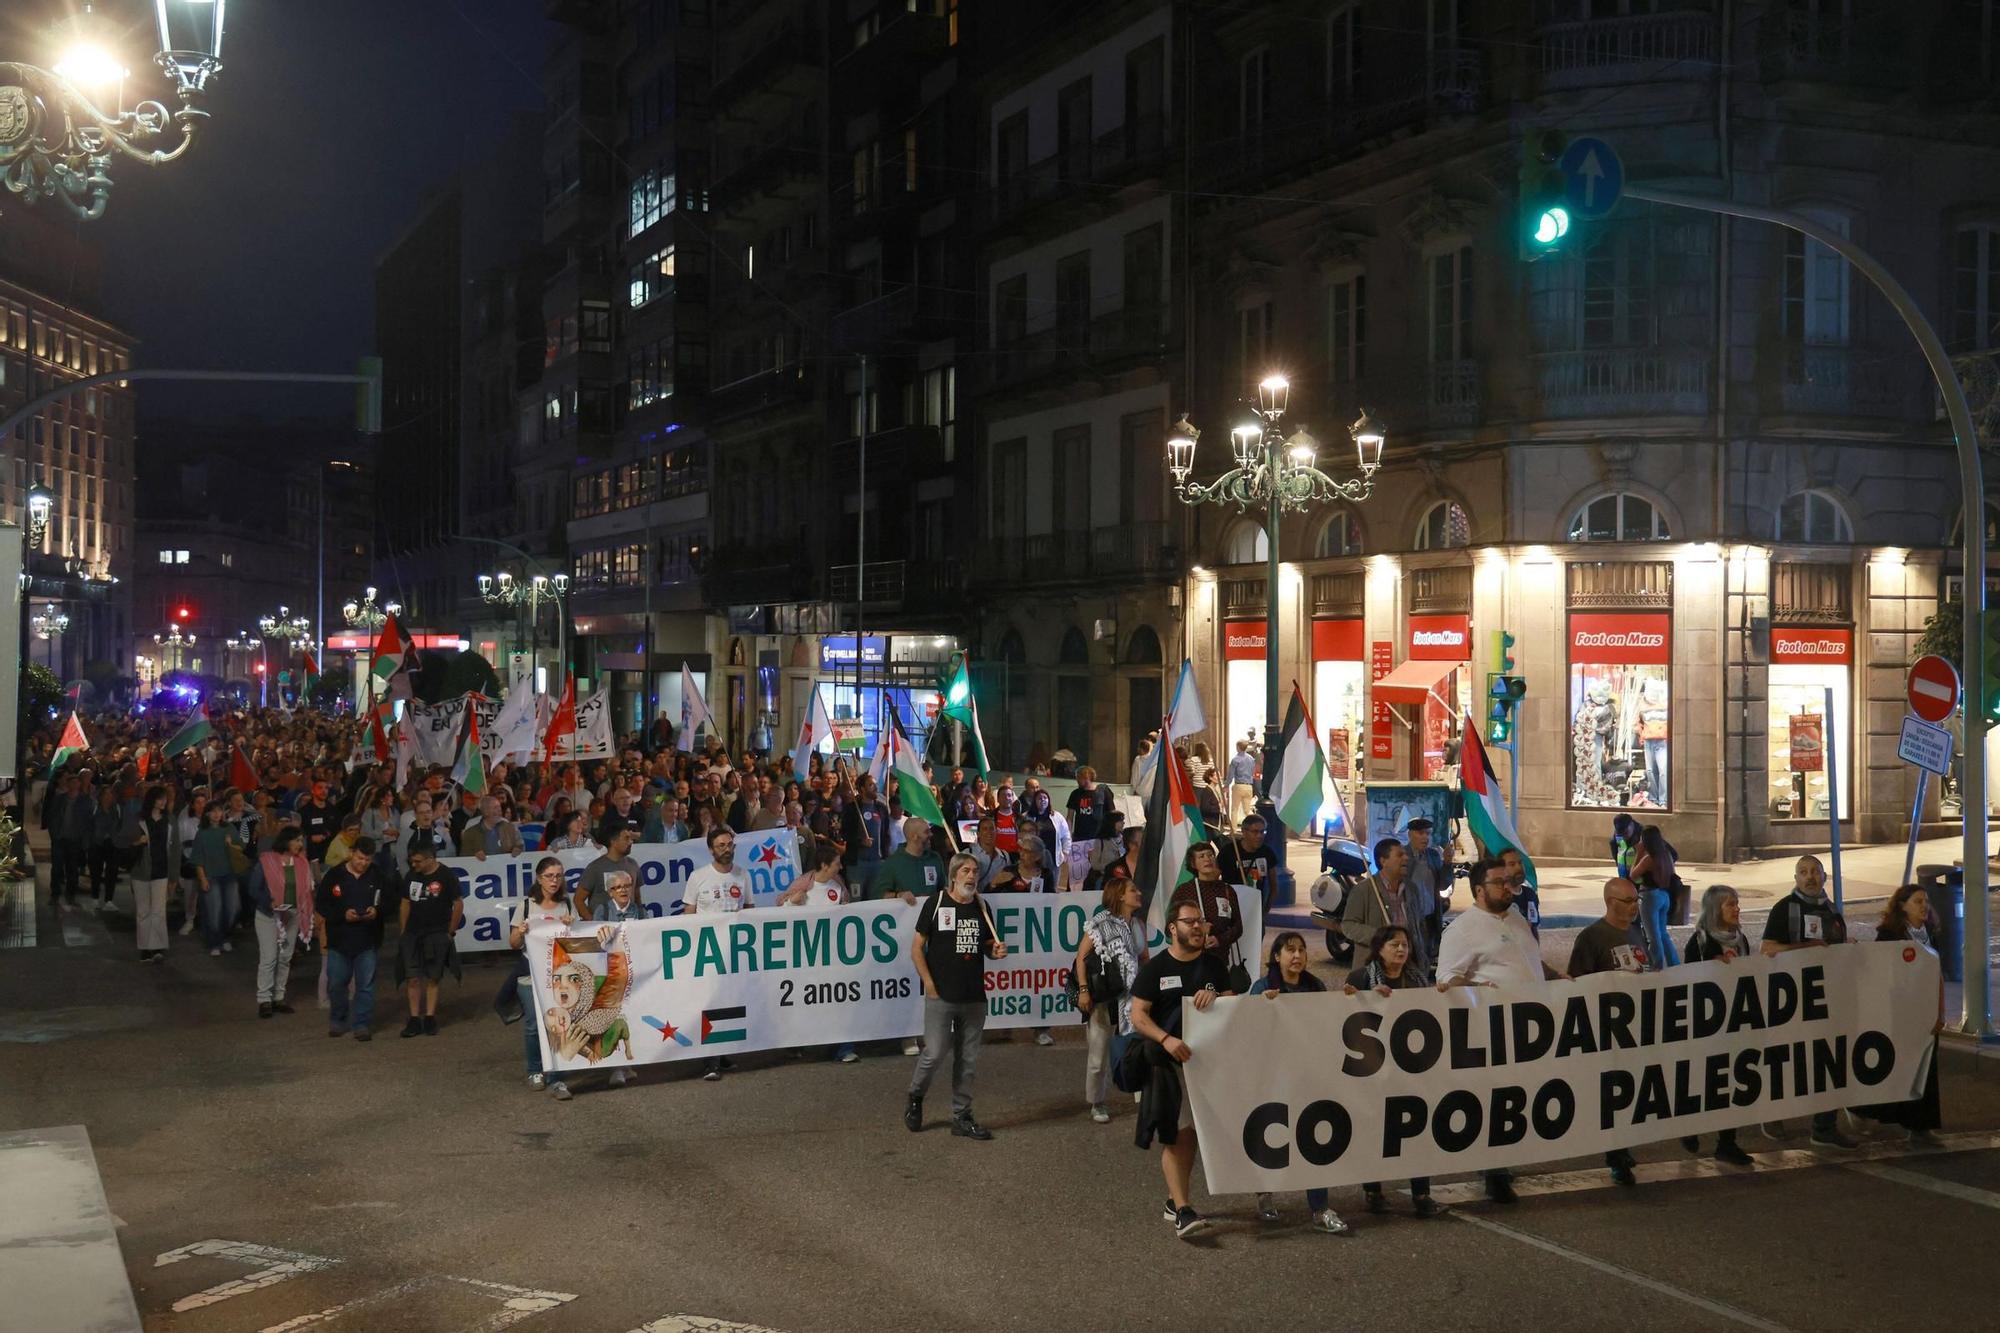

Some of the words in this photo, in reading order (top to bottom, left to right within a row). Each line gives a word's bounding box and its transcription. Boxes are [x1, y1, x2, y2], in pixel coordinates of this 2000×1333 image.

[1228, 635, 1243, 647] Foot
[1251, 635, 1266, 647] Mars
[1413, 631, 1431, 645] Foot
[1431, 633, 1442, 645] on
[1442, 631, 1464, 645] Mars
[1575, 632, 1607, 647] Foot
[1607, 636, 1625, 646] on
[1627, 632, 1664, 646] Mars
[1776, 639, 1802, 653] Foot
[1802, 642, 1816, 653] on
[1816, 639, 1845, 653] Mars
[449, 862, 586, 900] Galia
[640, 857, 694, 886] on
[956, 919, 980, 929] ANTI
[956, 928, 980, 937] IMPE
[661, 913, 899, 980] PAREMOS
[956, 936, 980, 946] RIAL
[955, 944, 979, 954] ISTA
[779, 980, 794, 1007] 2
[803, 979, 861, 1005] anos
[870, 977, 911, 1001] nas
[983, 966, 1068, 995] sempre
[990, 994, 1032, 1016] usa
[1342, 964, 1829, 1078] SOLIDARIEDADE
[1242, 1099, 1353, 1170] CO
[1382, 1077, 1576, 1159] POBO
[1600, 1030, 1896, 1131] PALESTINO
